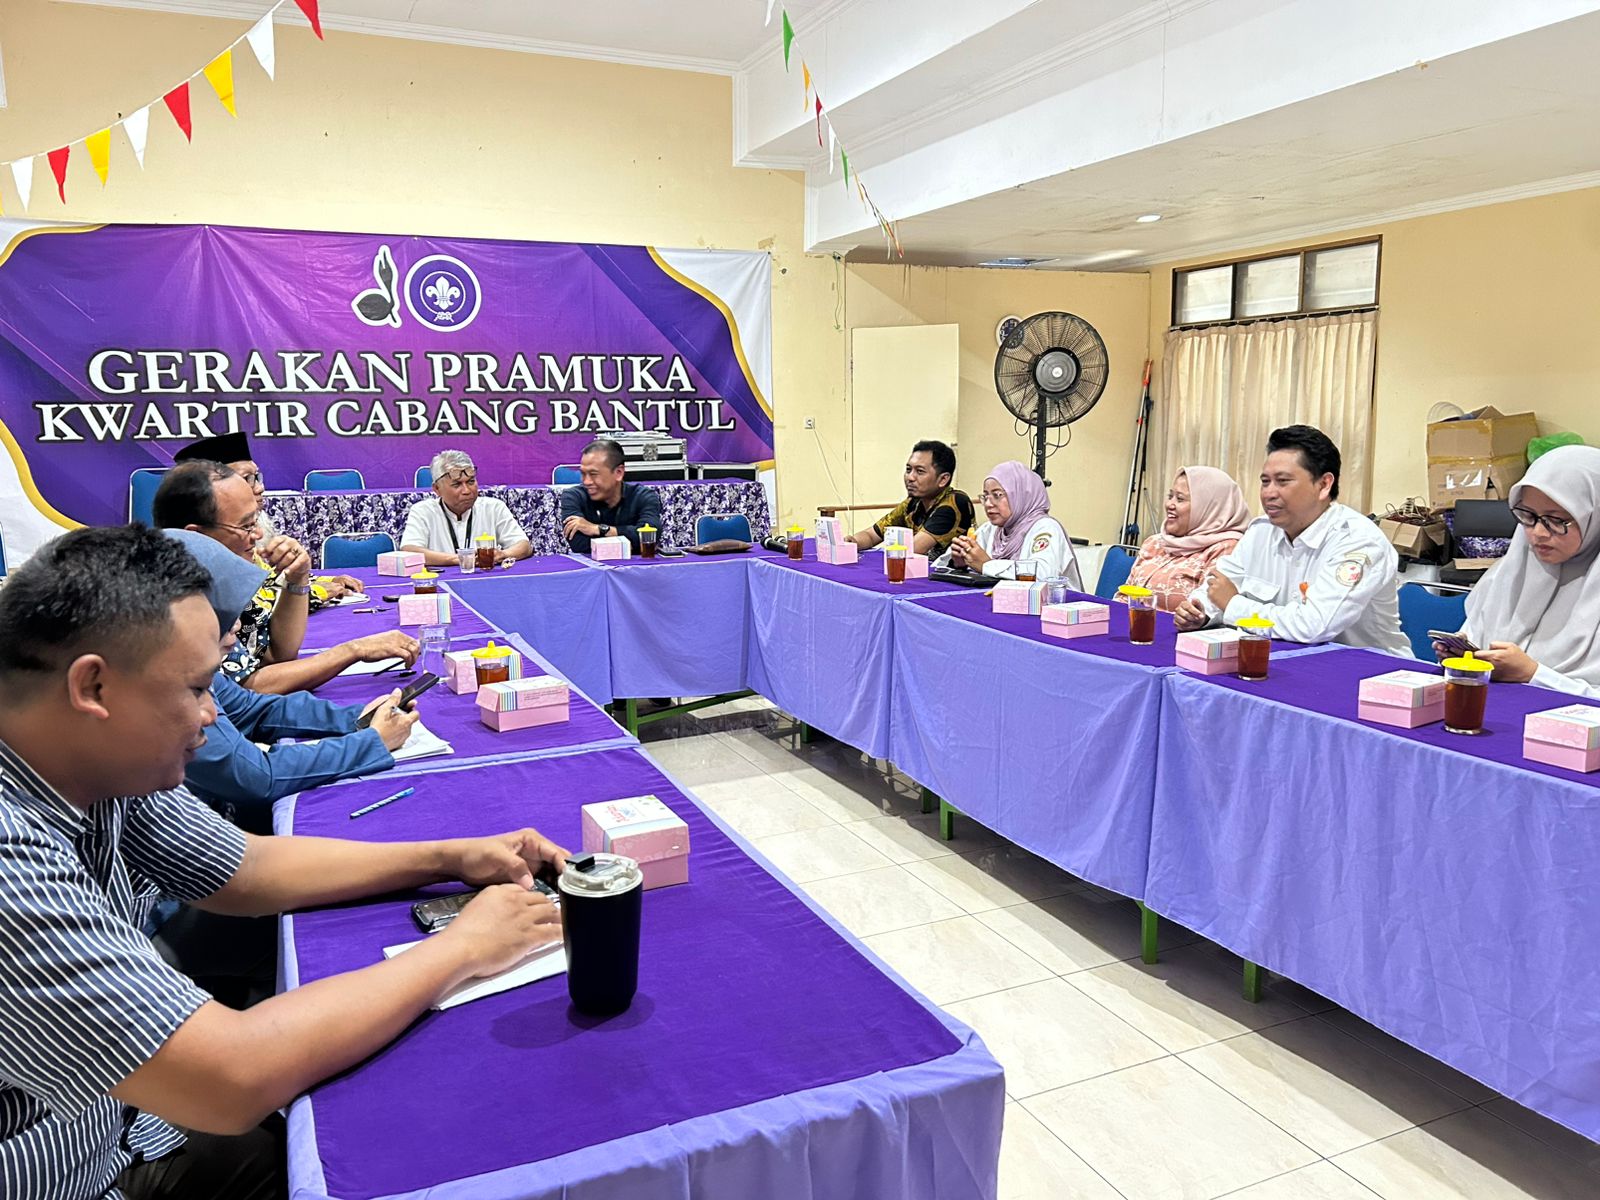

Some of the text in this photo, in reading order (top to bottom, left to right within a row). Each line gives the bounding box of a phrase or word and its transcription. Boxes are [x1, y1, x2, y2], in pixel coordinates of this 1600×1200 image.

[88, 350, 696, 394] GERAKAN PRAMUKA
[35, 398, 736, 441] KWARTIR CABANG BANTUL
